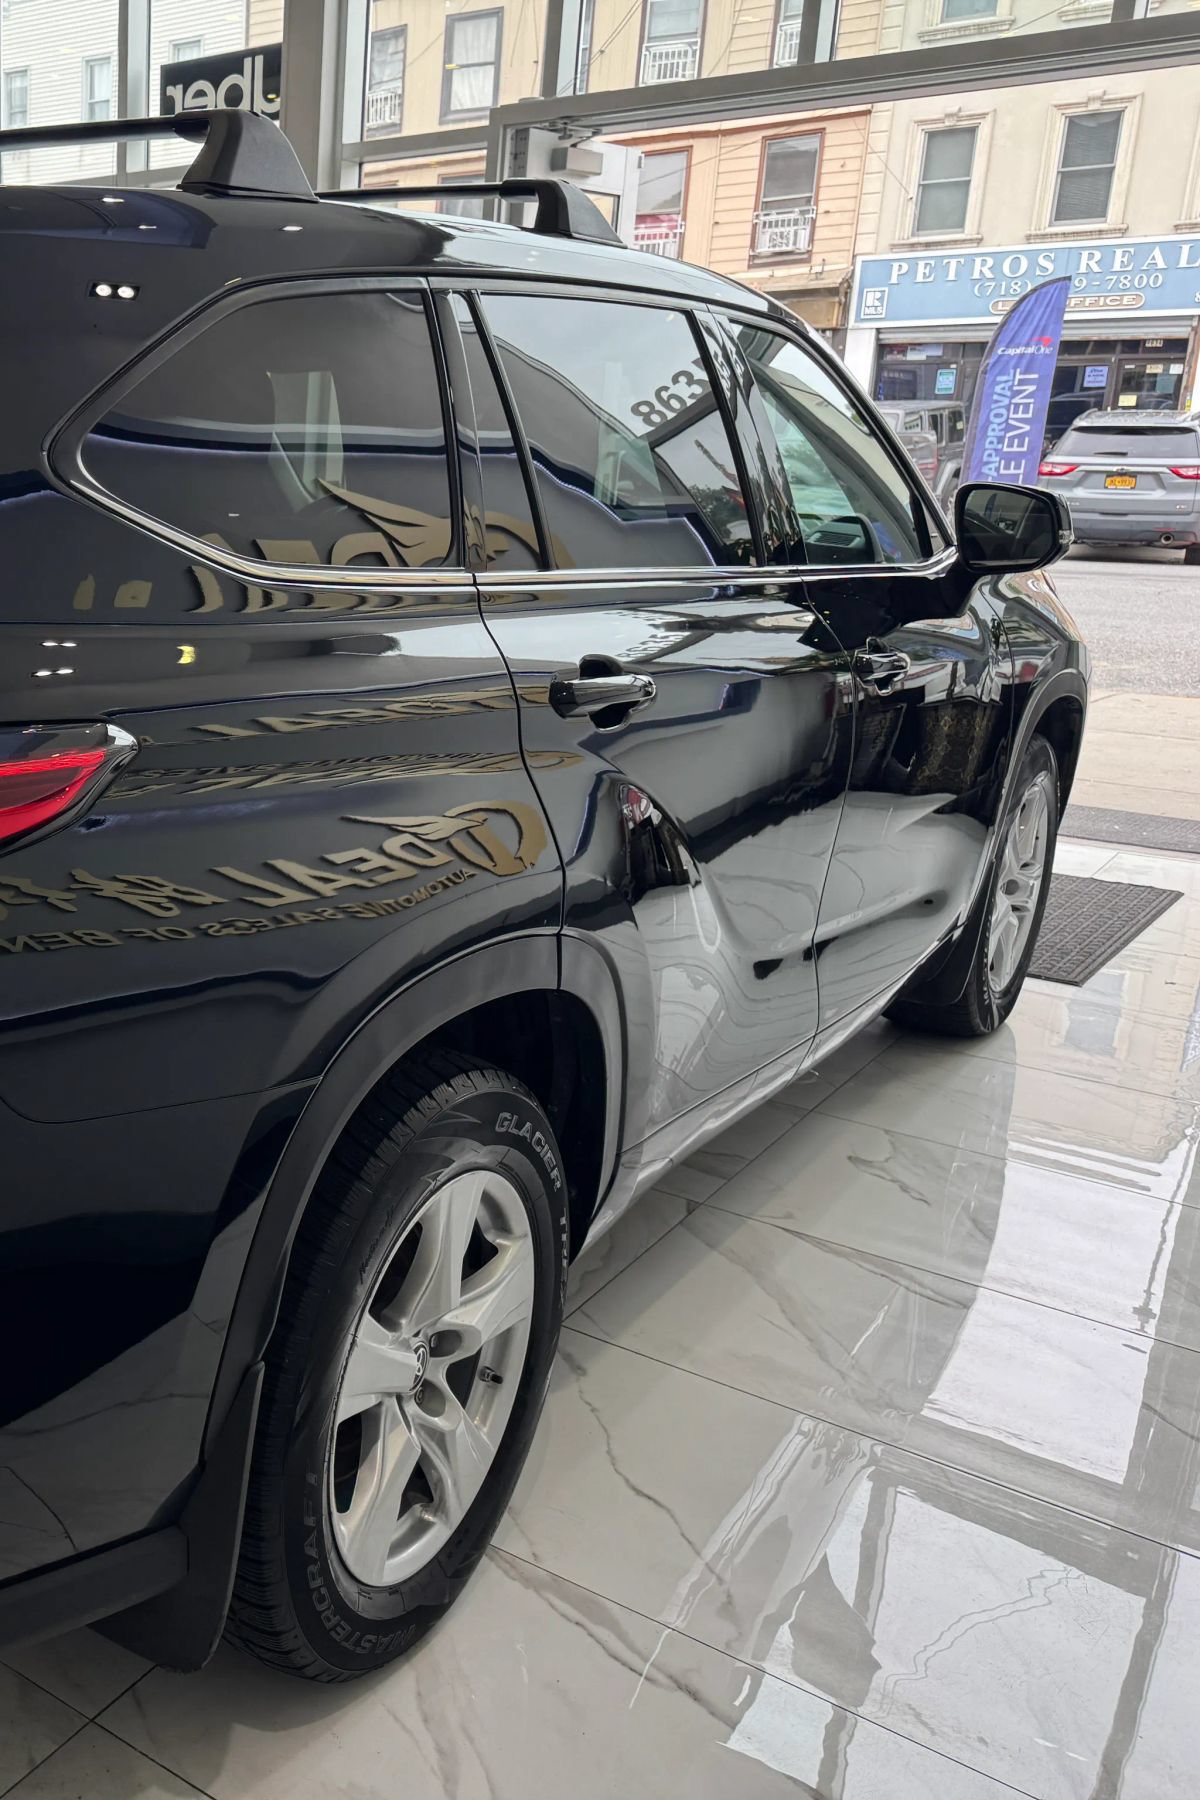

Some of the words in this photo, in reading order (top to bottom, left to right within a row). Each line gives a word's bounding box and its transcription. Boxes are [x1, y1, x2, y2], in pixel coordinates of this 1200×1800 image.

[888, 250, 1056, 285] PETROS
[1076, 243, 1200, 274] REAL
[973, 279, 1032, 297] (718)
[1073, 272, 1163, 293] 9-7800
[1065, 294, 1137, 308] FFICE
[1003, 368, 1039, 452] EVENT
[495, 1112, 562, 1192] GLACIER
